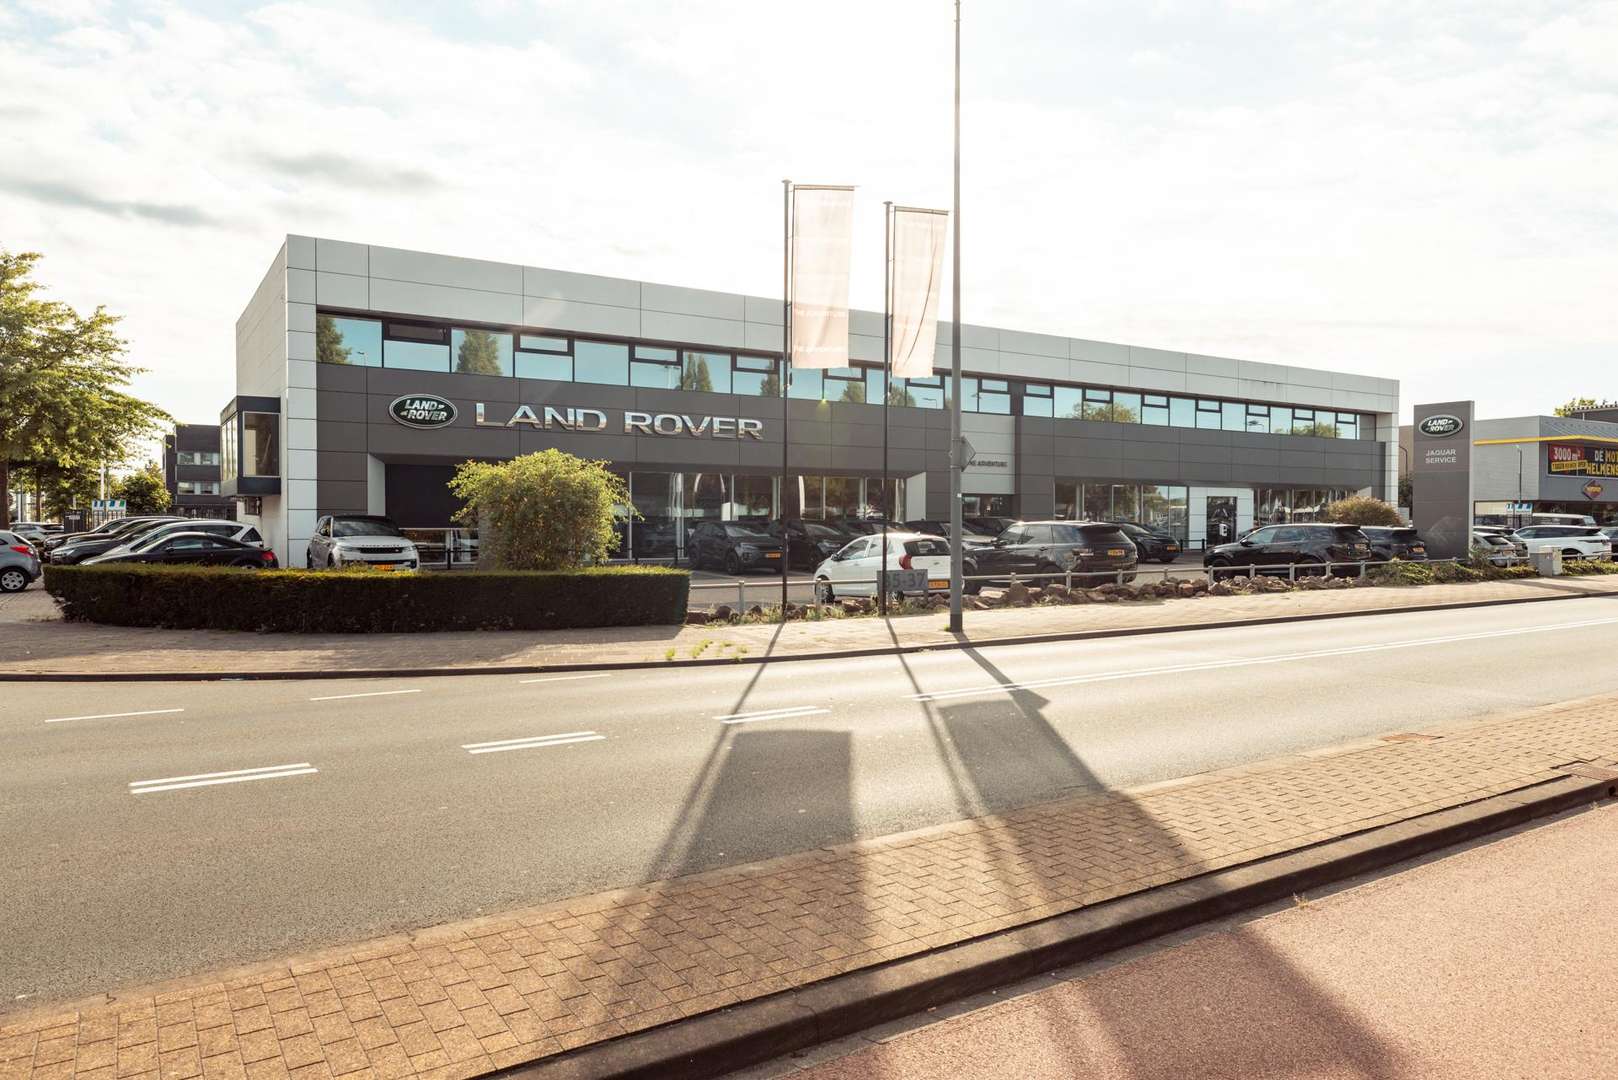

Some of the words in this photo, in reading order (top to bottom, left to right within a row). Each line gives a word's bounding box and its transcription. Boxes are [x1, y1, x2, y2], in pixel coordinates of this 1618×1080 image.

[405, 400, 437, 410] LAND
[407, 409, 448, 421] ROVER
[475, 402, 607, 431] LAND
[624, 411, 763, 440] ROVER
[1553, 447, 1572, 461] 3000
[1594, 449, 1605, 462] DE
